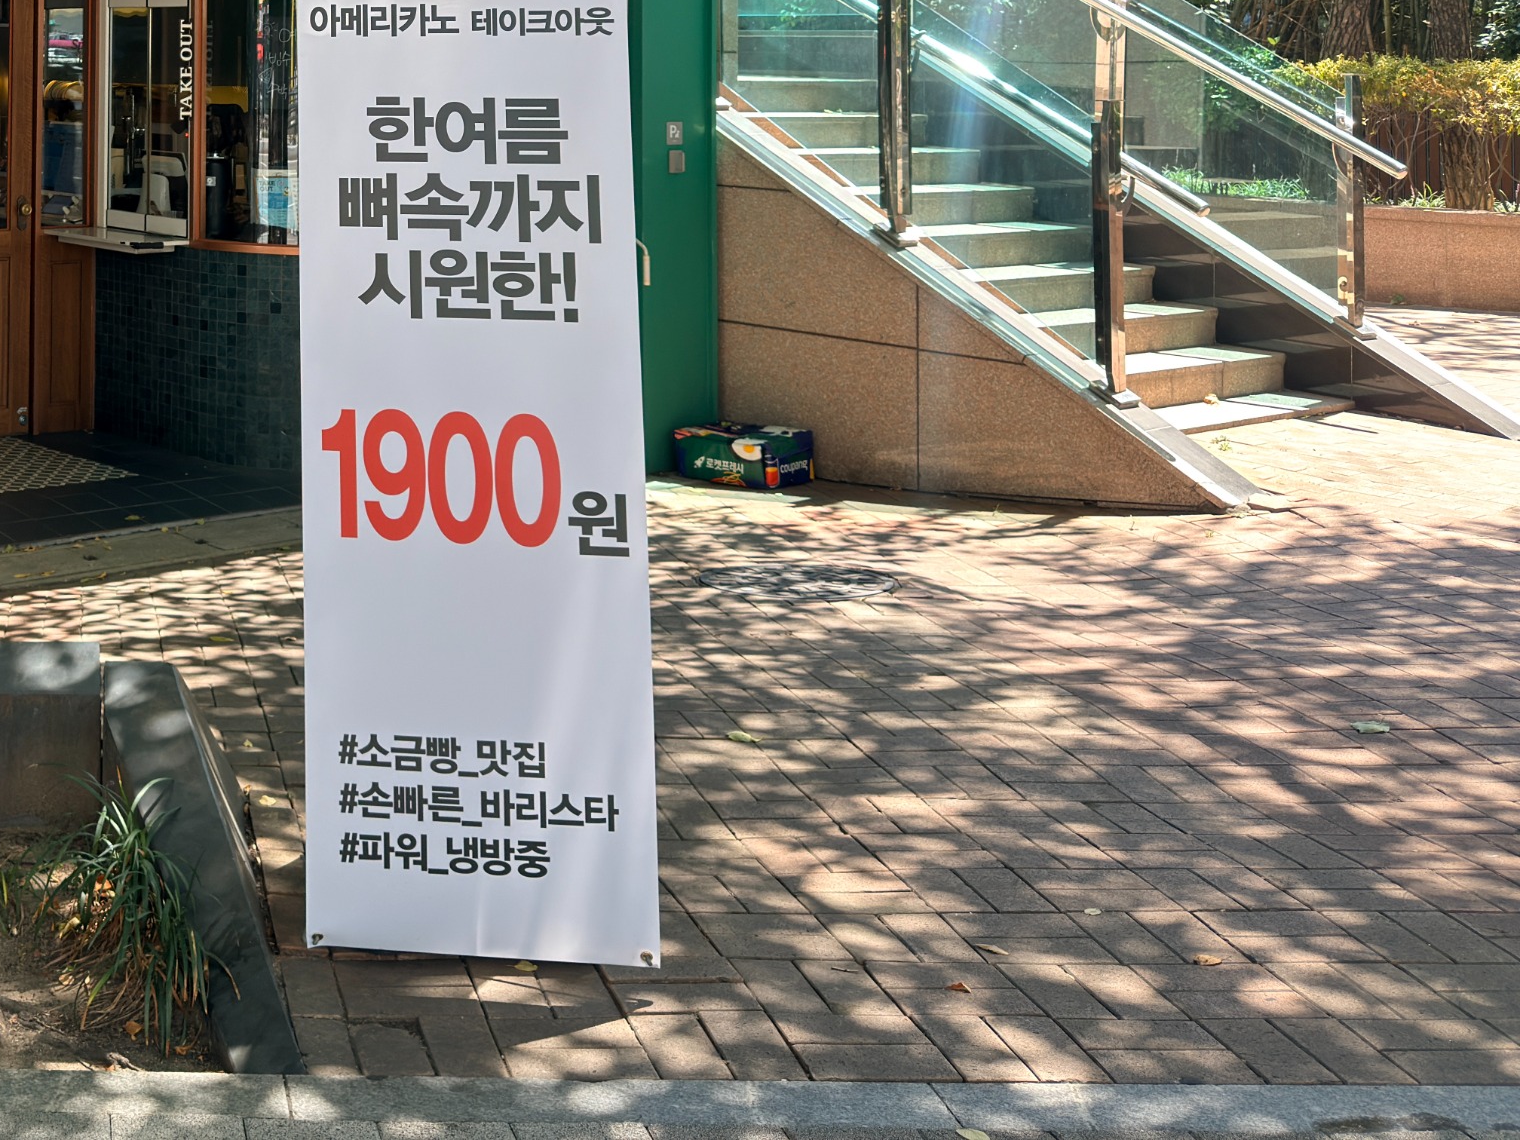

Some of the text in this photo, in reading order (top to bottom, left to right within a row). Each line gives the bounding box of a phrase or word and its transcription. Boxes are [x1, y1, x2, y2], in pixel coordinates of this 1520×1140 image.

[309, 3, 460, 37] 아메리카노
[470, 6, 615, 37] 테이크아웃
[180, 19, 193, 120] TAKE OUT
[366, 96, 568, 164] 한여름
[338, 172, 602, 244] 뼈속까지
[357, 249, 579, 323] 시원한!
[706, 457, 744, 474] 로켓프레시
[780, 459, 808, 474] coupang
[338, 733, 547, 779] #소금빵_맛집
[338, 780, 619, 833] #손빠른_바리스타
[338, 831, 550, 879] #파워_냉방중
